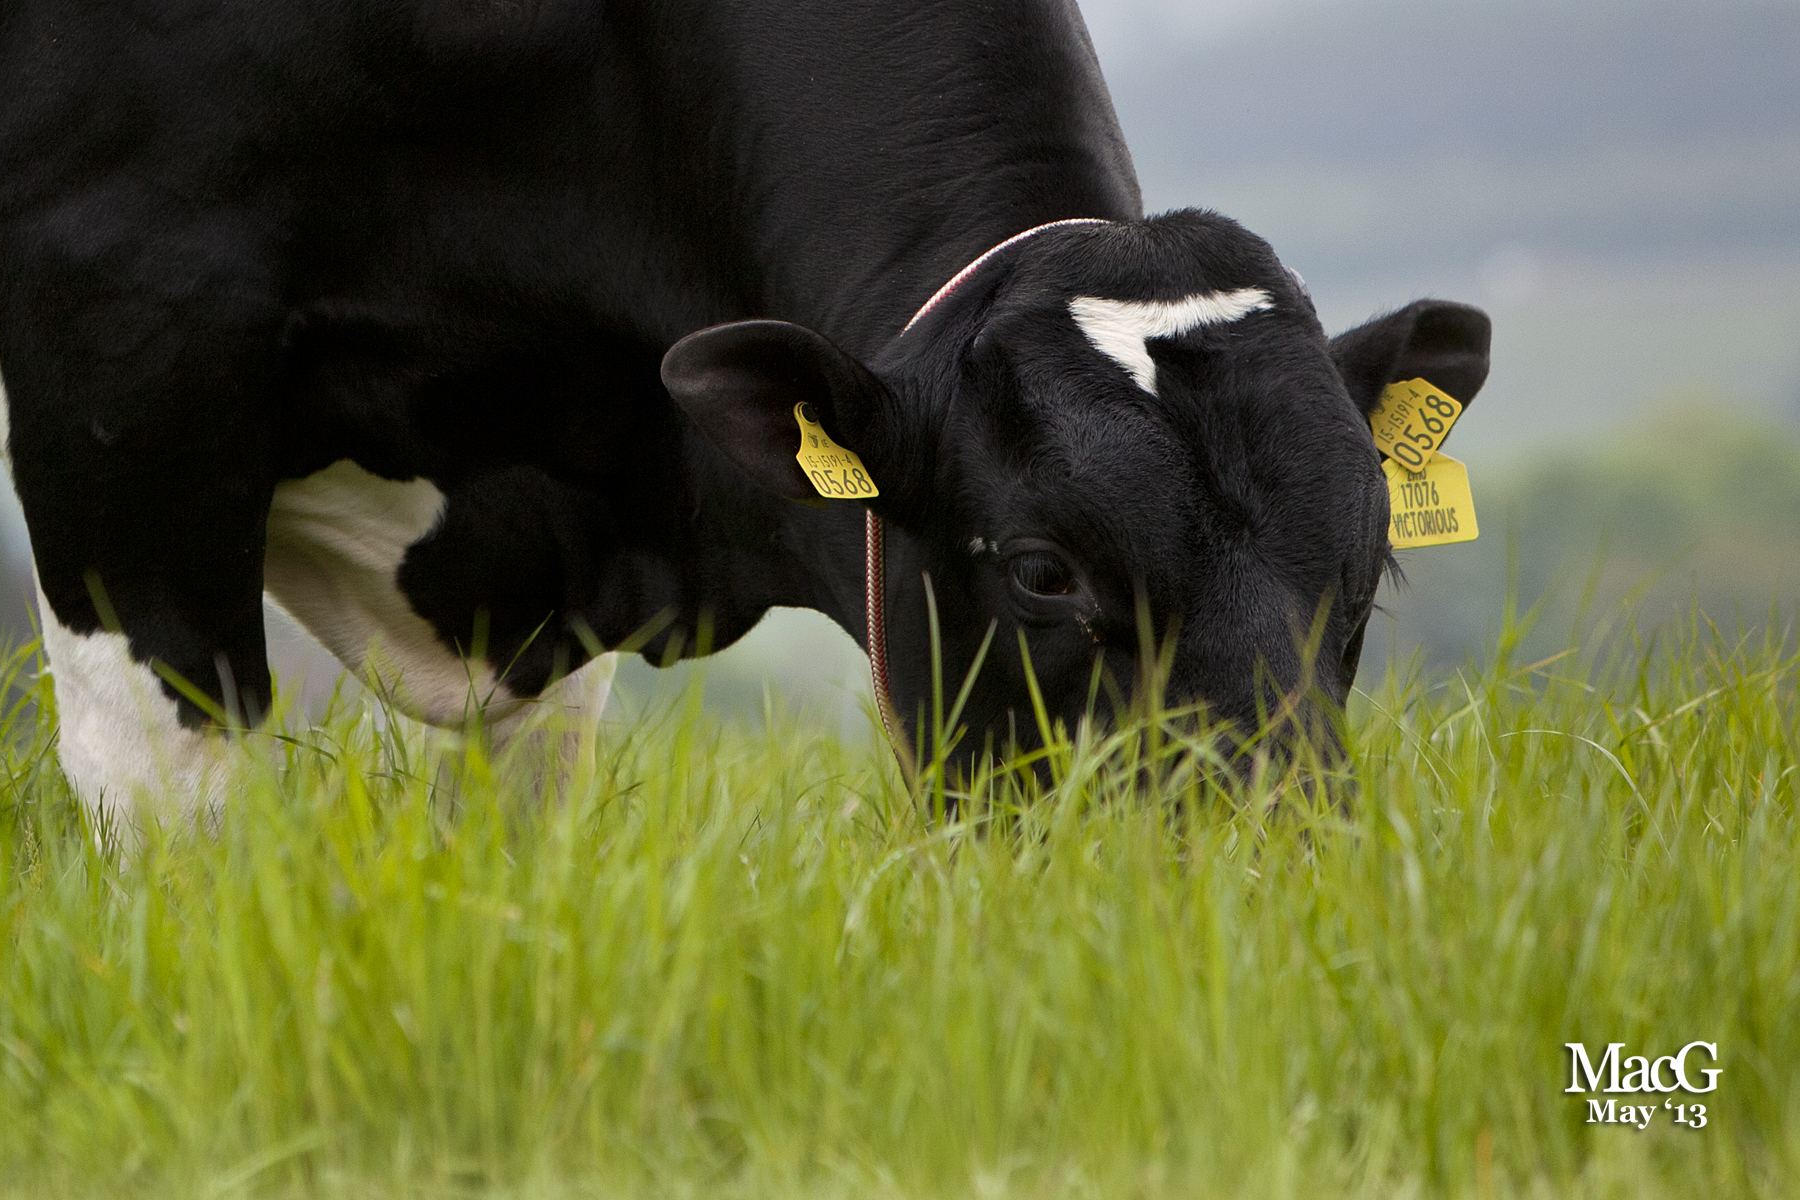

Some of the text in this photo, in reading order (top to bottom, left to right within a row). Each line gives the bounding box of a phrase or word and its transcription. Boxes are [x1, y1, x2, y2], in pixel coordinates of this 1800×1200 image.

[1377, 388, 1421, 444] 15-15191-4
[1393, 394, 1455, 466] 0568
[804, 453, 854, 468] 15-15191-4
[811, 467, 873, 495] 0568
[1400, 480, 1440, 509] 17076
[1391, 506, 1459, 539] VICTORIOUS
